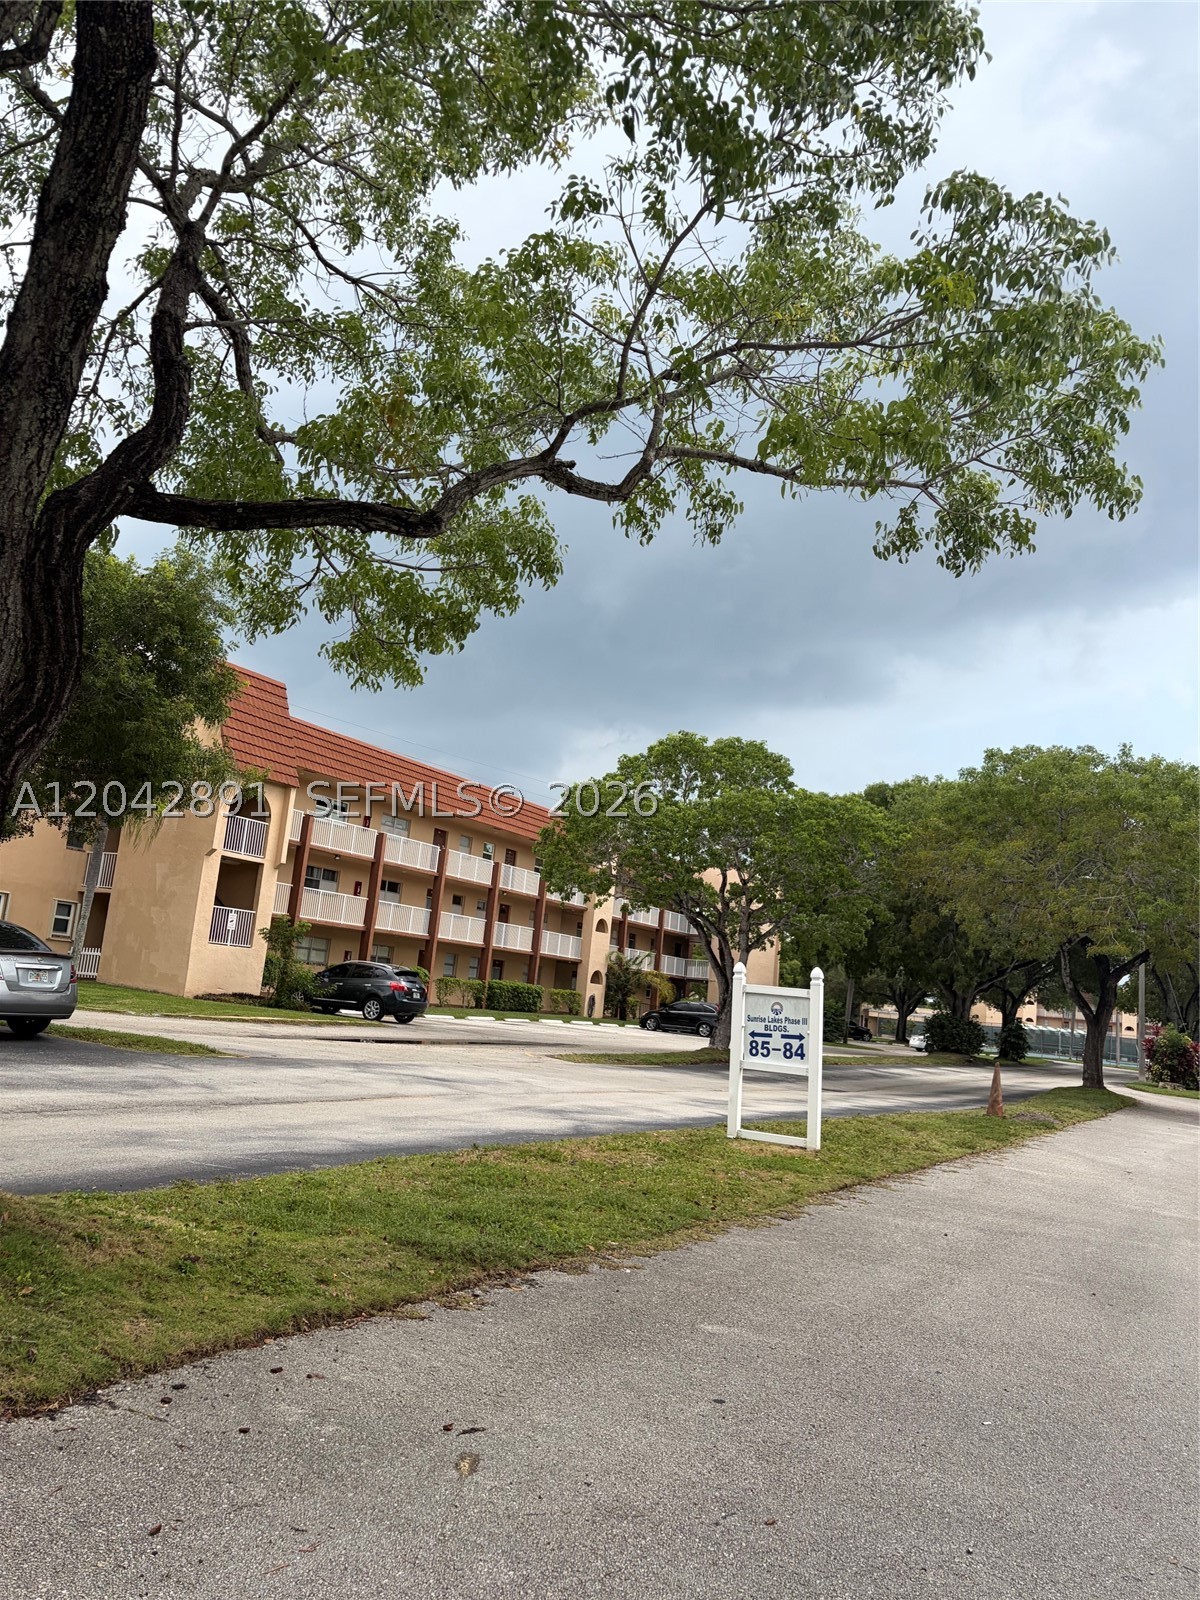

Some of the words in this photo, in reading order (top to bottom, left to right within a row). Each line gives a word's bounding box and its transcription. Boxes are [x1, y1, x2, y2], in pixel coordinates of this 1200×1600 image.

[747, 1015, 766, 1023] Sunrise
[768, 1016, 783, 1024] Lakes
[785, 1017, 800, 1025] Phase
